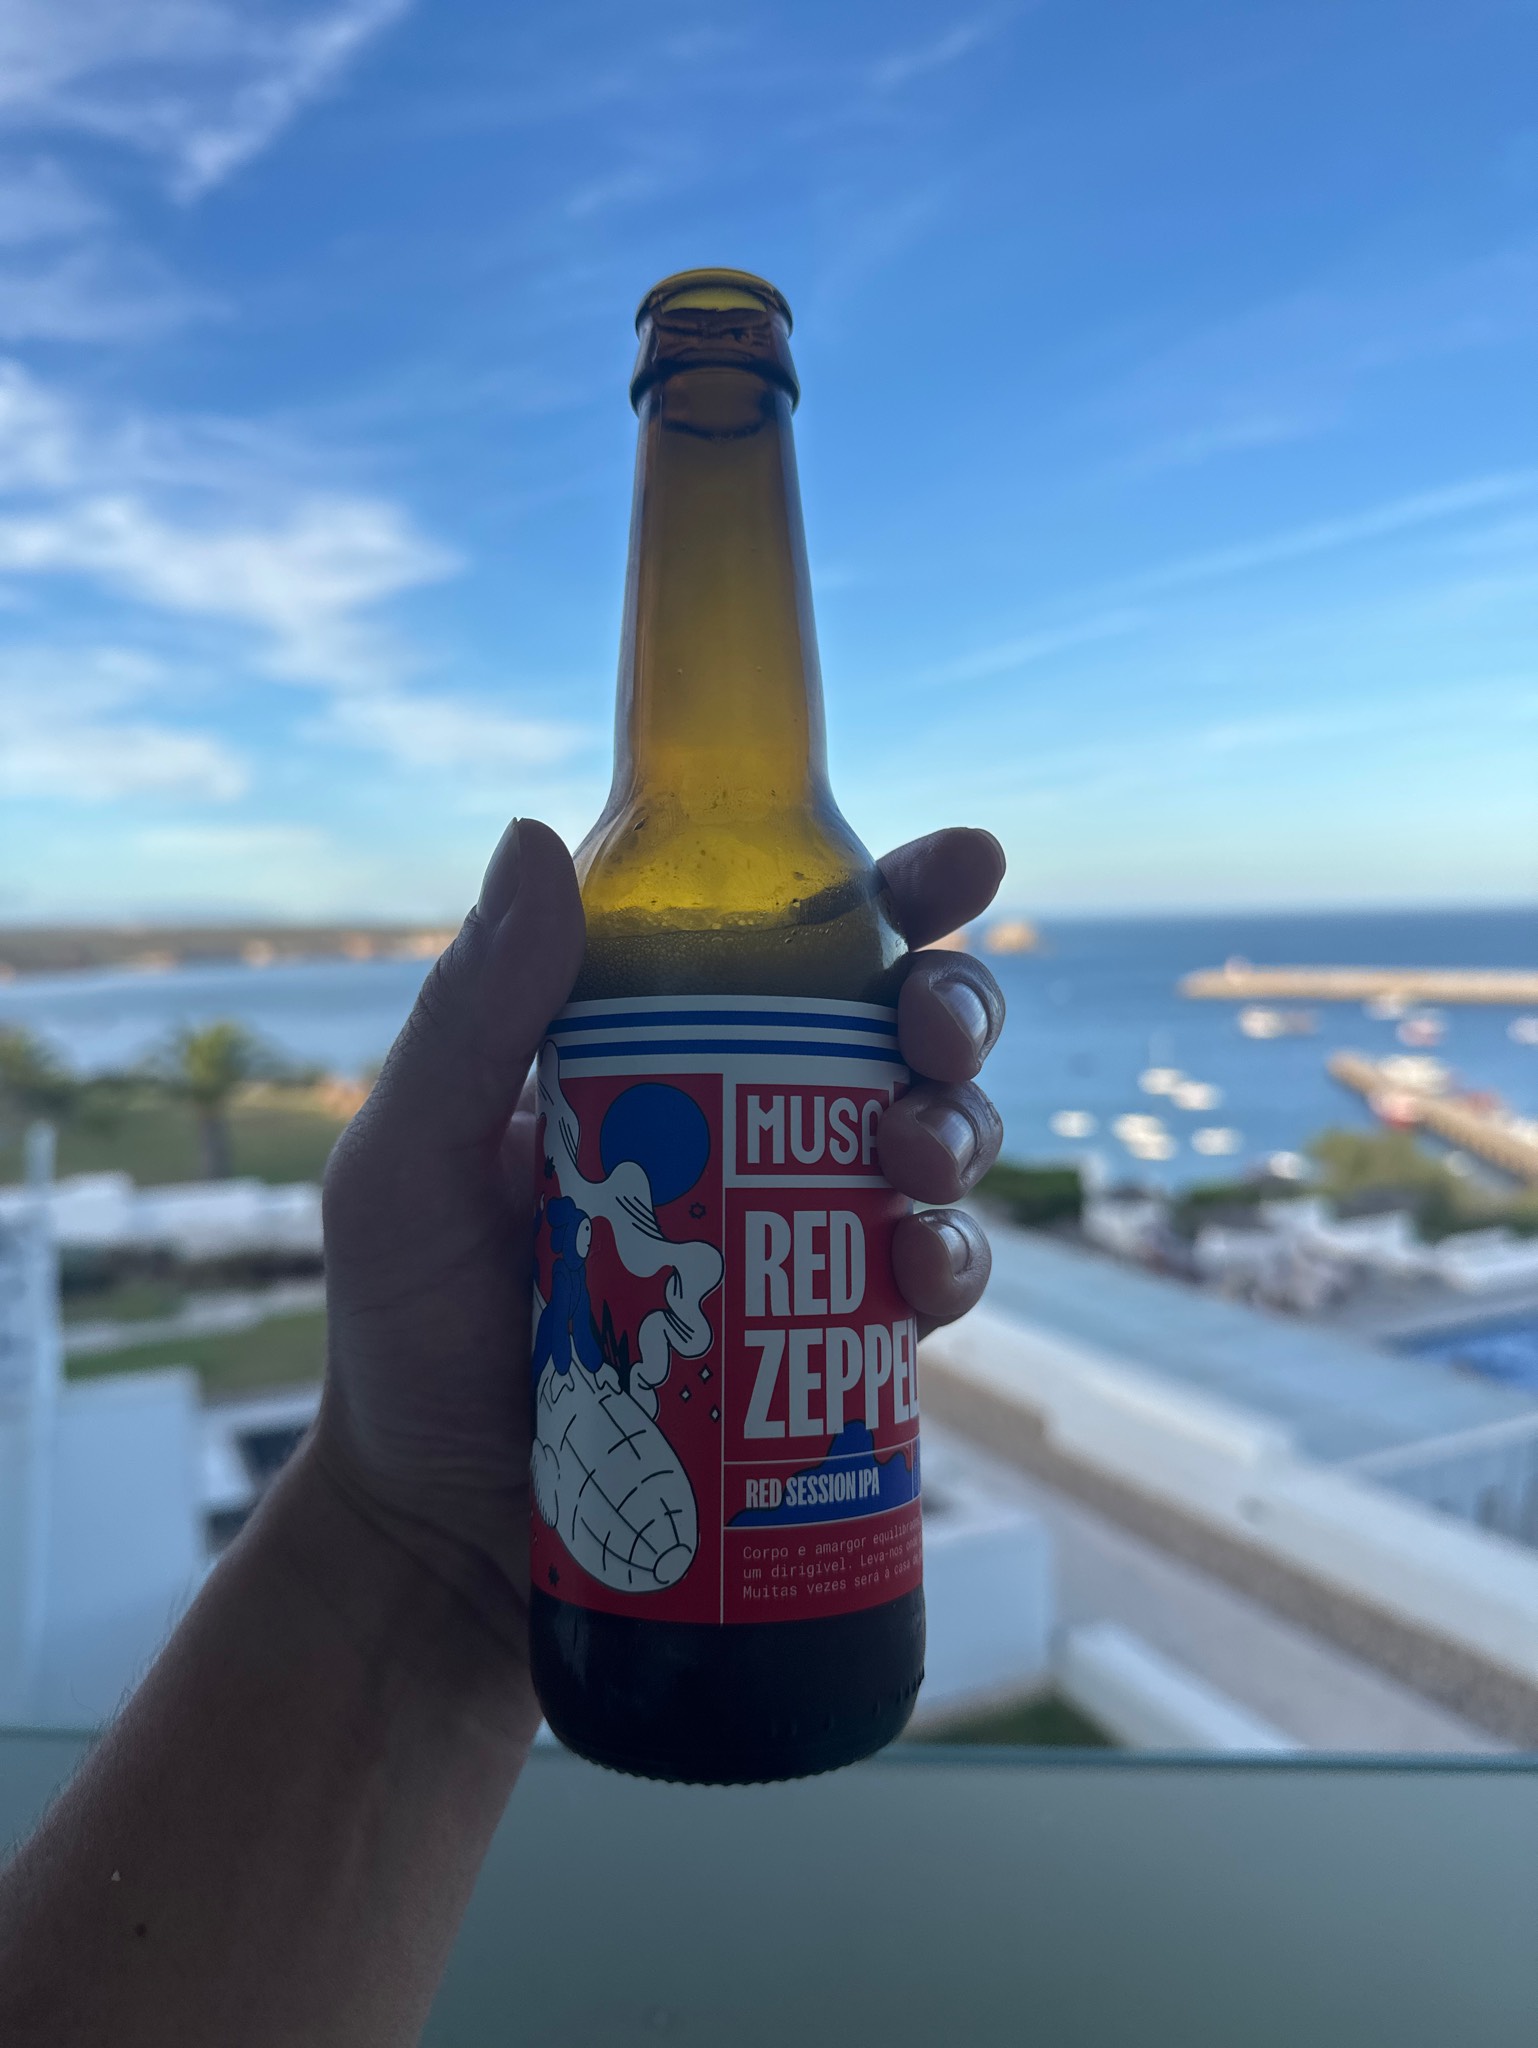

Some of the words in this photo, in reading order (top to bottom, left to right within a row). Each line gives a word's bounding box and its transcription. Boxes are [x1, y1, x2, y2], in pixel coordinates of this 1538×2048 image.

[747, 1095, 883, 1165] MUSA
[745, 1210, 866, 1317] RED
[743, 1317, 919, 1439] ZEPPEL
[745, 1478, 783, 1508] RED
[785, 1470, 856, 1506] SESSION
[858, 1467, 880, 1498] IPA
[743, 1546, 789, 1561] Corpo
[798, 1545, 806, 1556] e
[815, 1536, 867, 1554] amargor
[743, 1568, 762, 1579] um
[771, 1557, 852, 1578] dirigível.
[860, 1544, 903, 1567] Leva-nos
[743, 1584, 798, 1599] Muitas
[807, 1579, 847, 1594] vezes
[854, 1569, 880, 1588] será
[893, 1559, 911, 1575] casa
